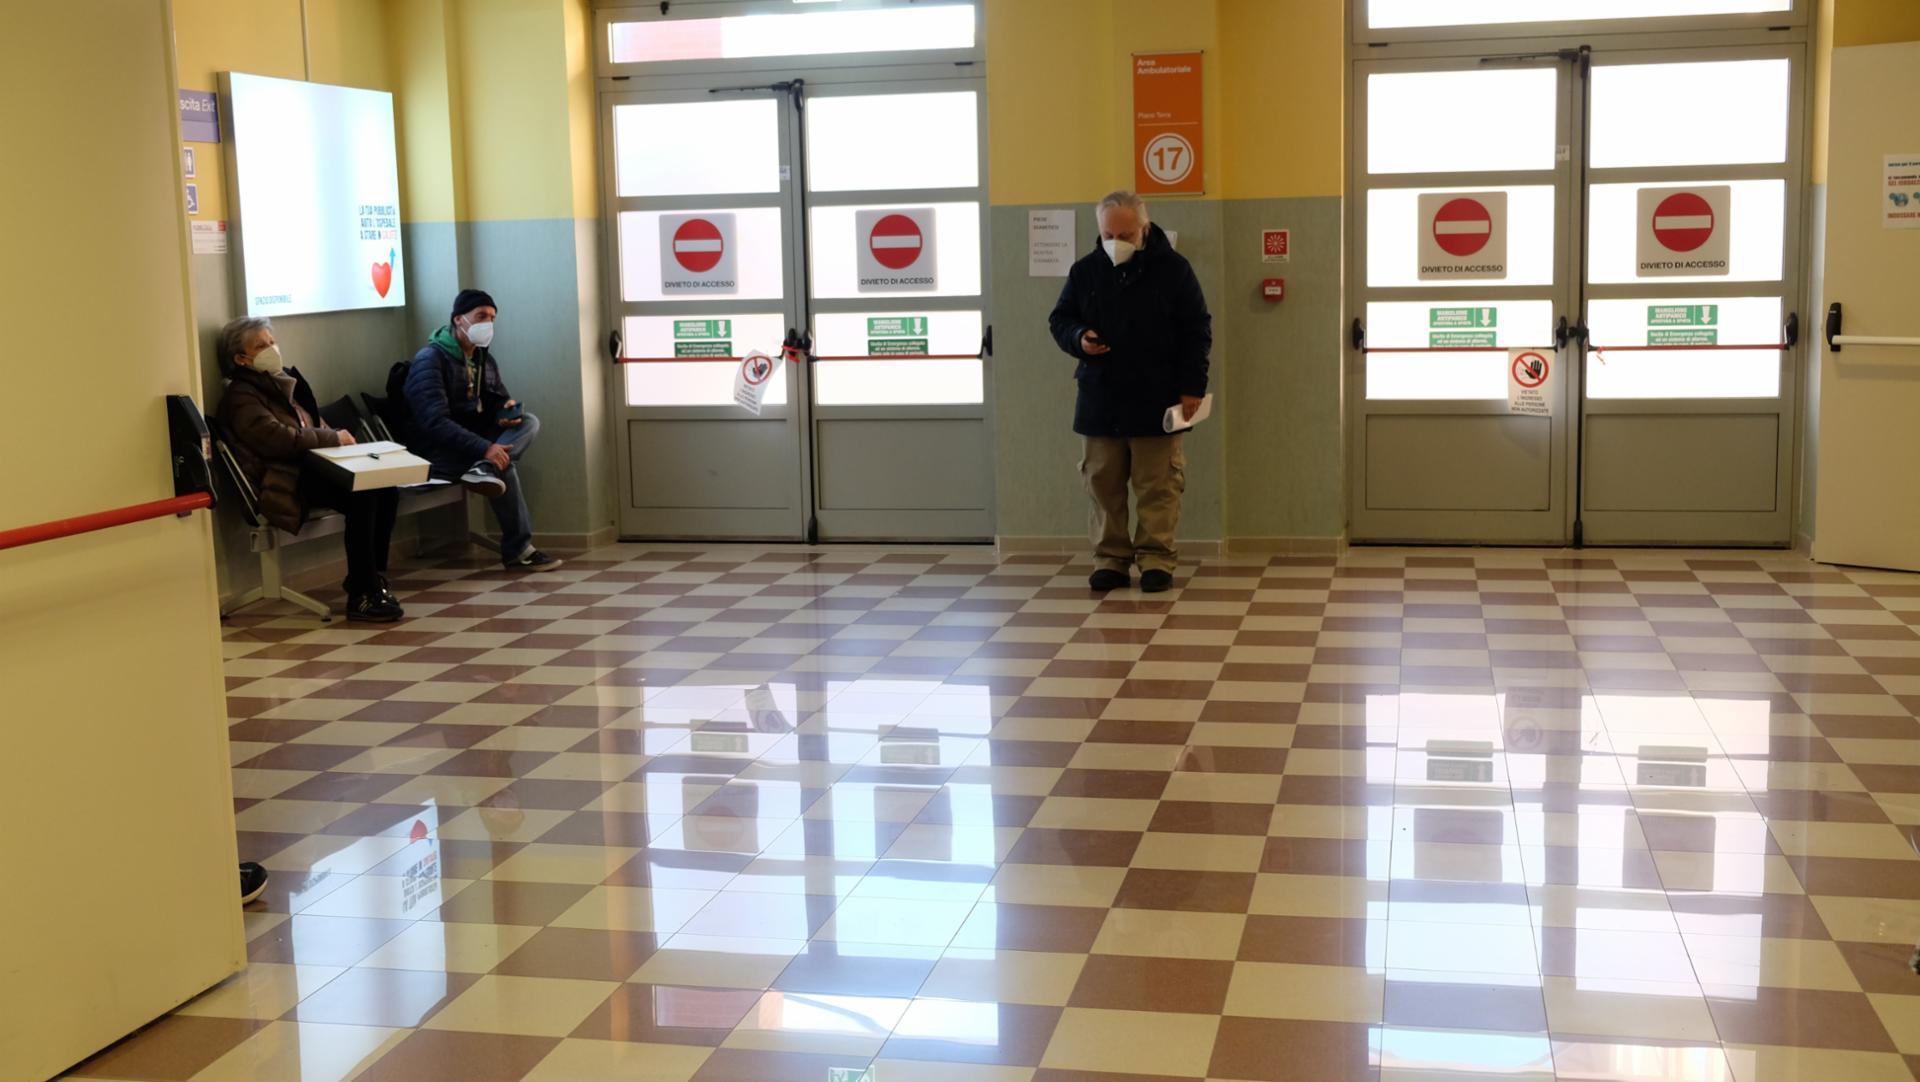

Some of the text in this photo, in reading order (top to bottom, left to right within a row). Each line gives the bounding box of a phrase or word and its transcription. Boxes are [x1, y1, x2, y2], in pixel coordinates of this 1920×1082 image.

[1137, 66, 1192, 75] Ambulatoriale
[202, 99, 215, 112] Exit
[1153, 147, 1184, 170] 17
[1421, 265, 1453, 273] DIVIETO
[1465, 264, 1503, 272] ACCESSO
[1640, 260, 1726, 270] DIVIETO DI ACCESSO
[664, 280, 735, 289] DIVIETO DI ACCESSO
[861, 278, 890, 286] DIVIETO
[900, 277, 935, 285] ACCESSO
